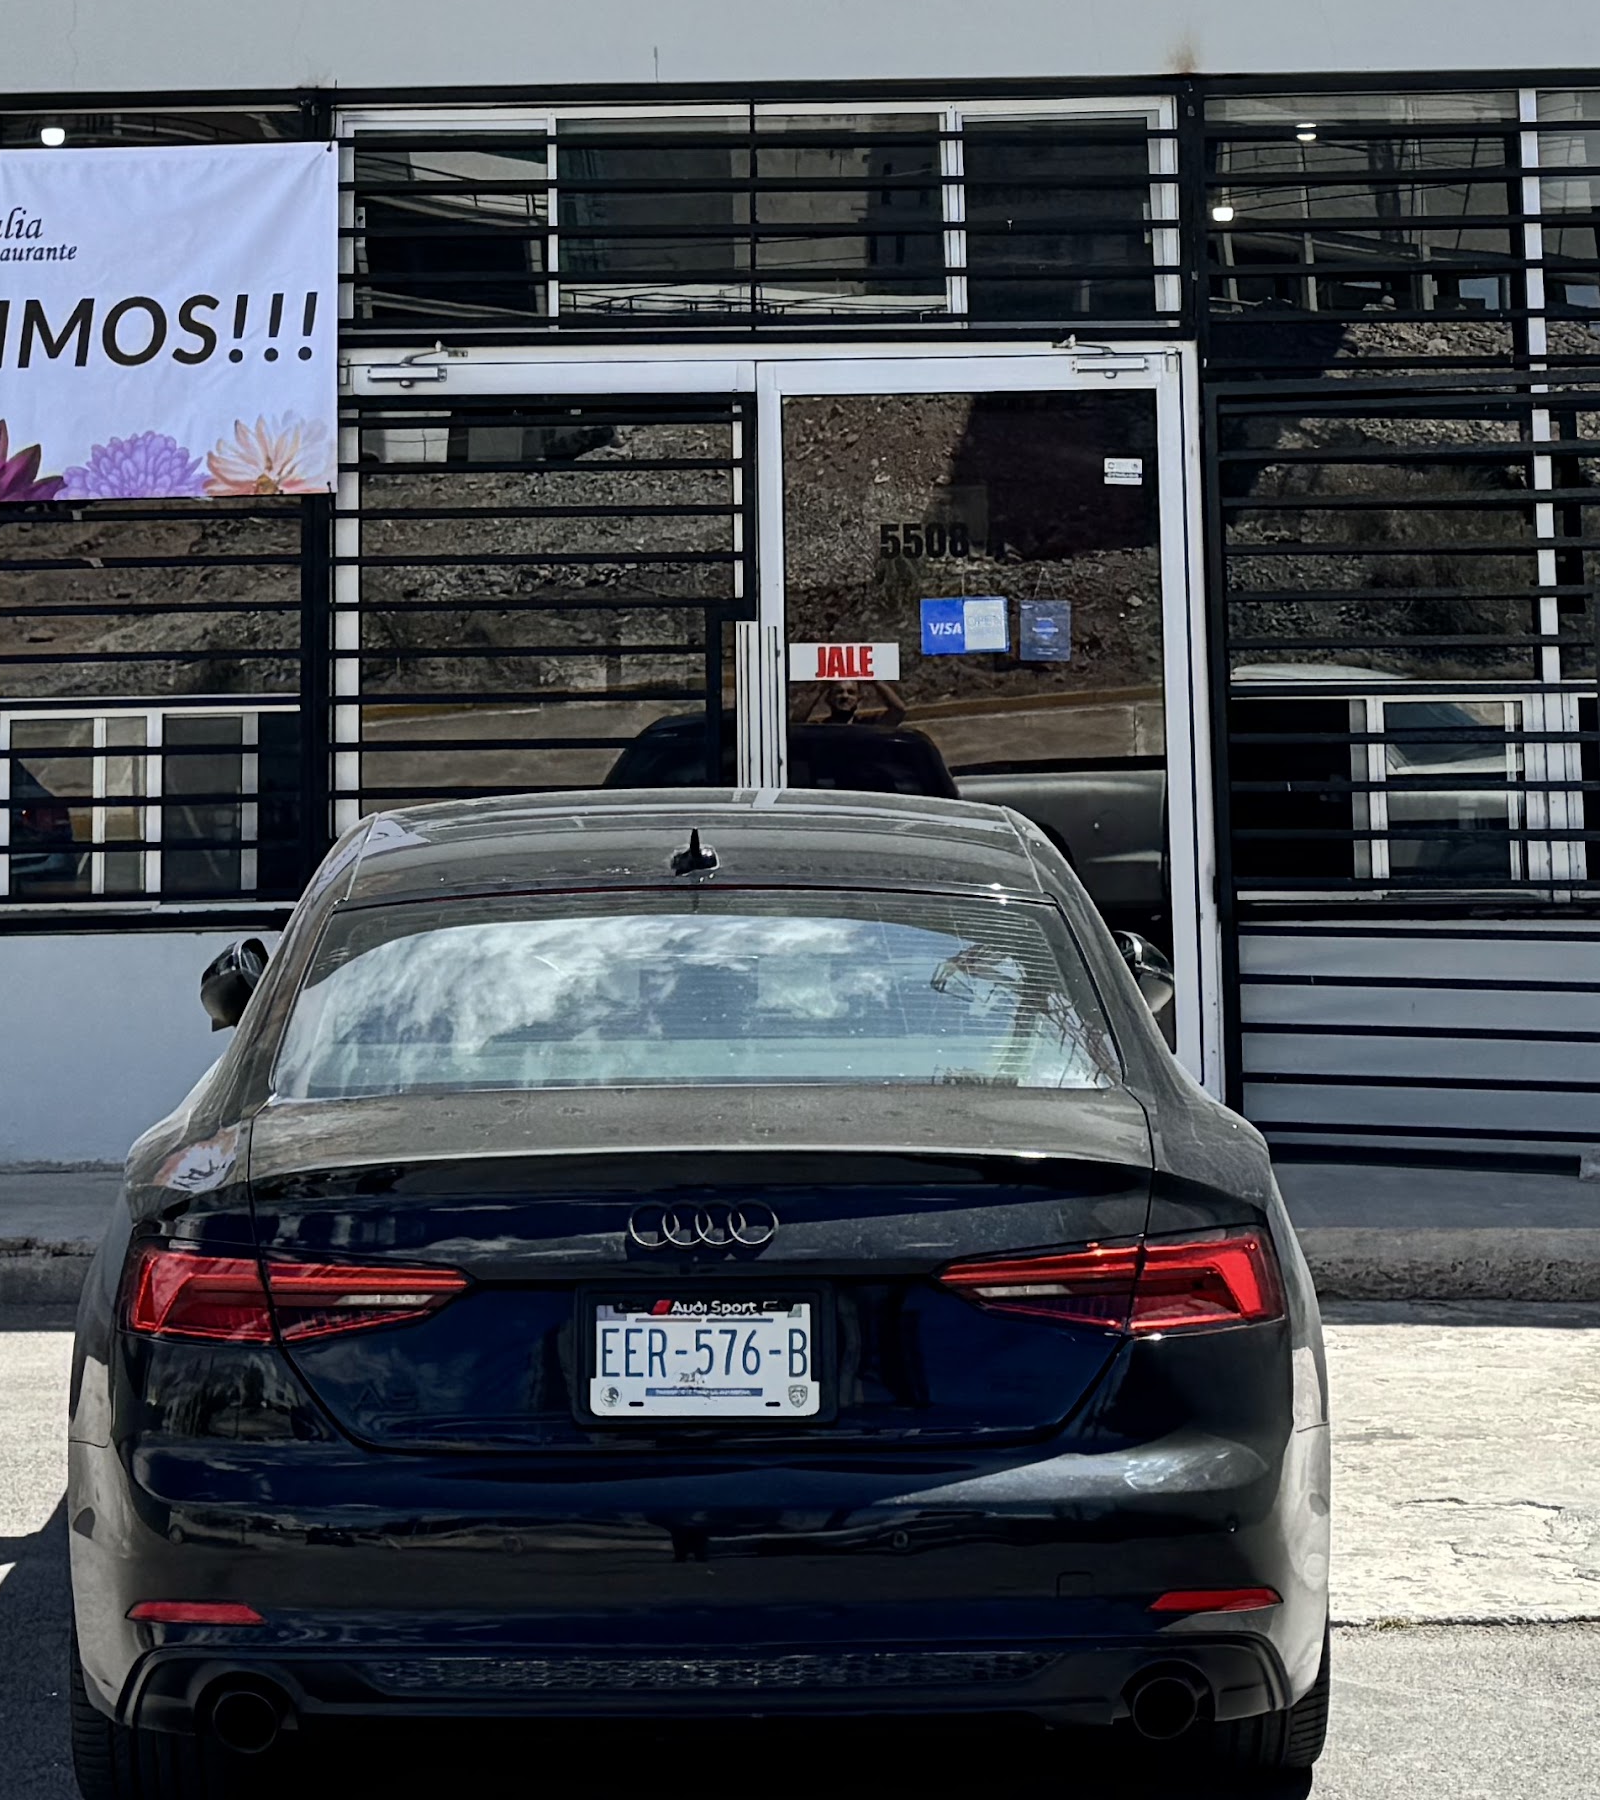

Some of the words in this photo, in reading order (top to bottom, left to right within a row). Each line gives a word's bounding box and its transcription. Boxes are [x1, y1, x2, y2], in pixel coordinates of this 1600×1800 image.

[929, 622, 962, 636] VISA
[815, 646, 875, 679] JALE
[671, 1300, 707, 1314] Audi
[711, 1300, 757, 1316] Sport
[601, 1328, 808, 1378] EER-576-B
